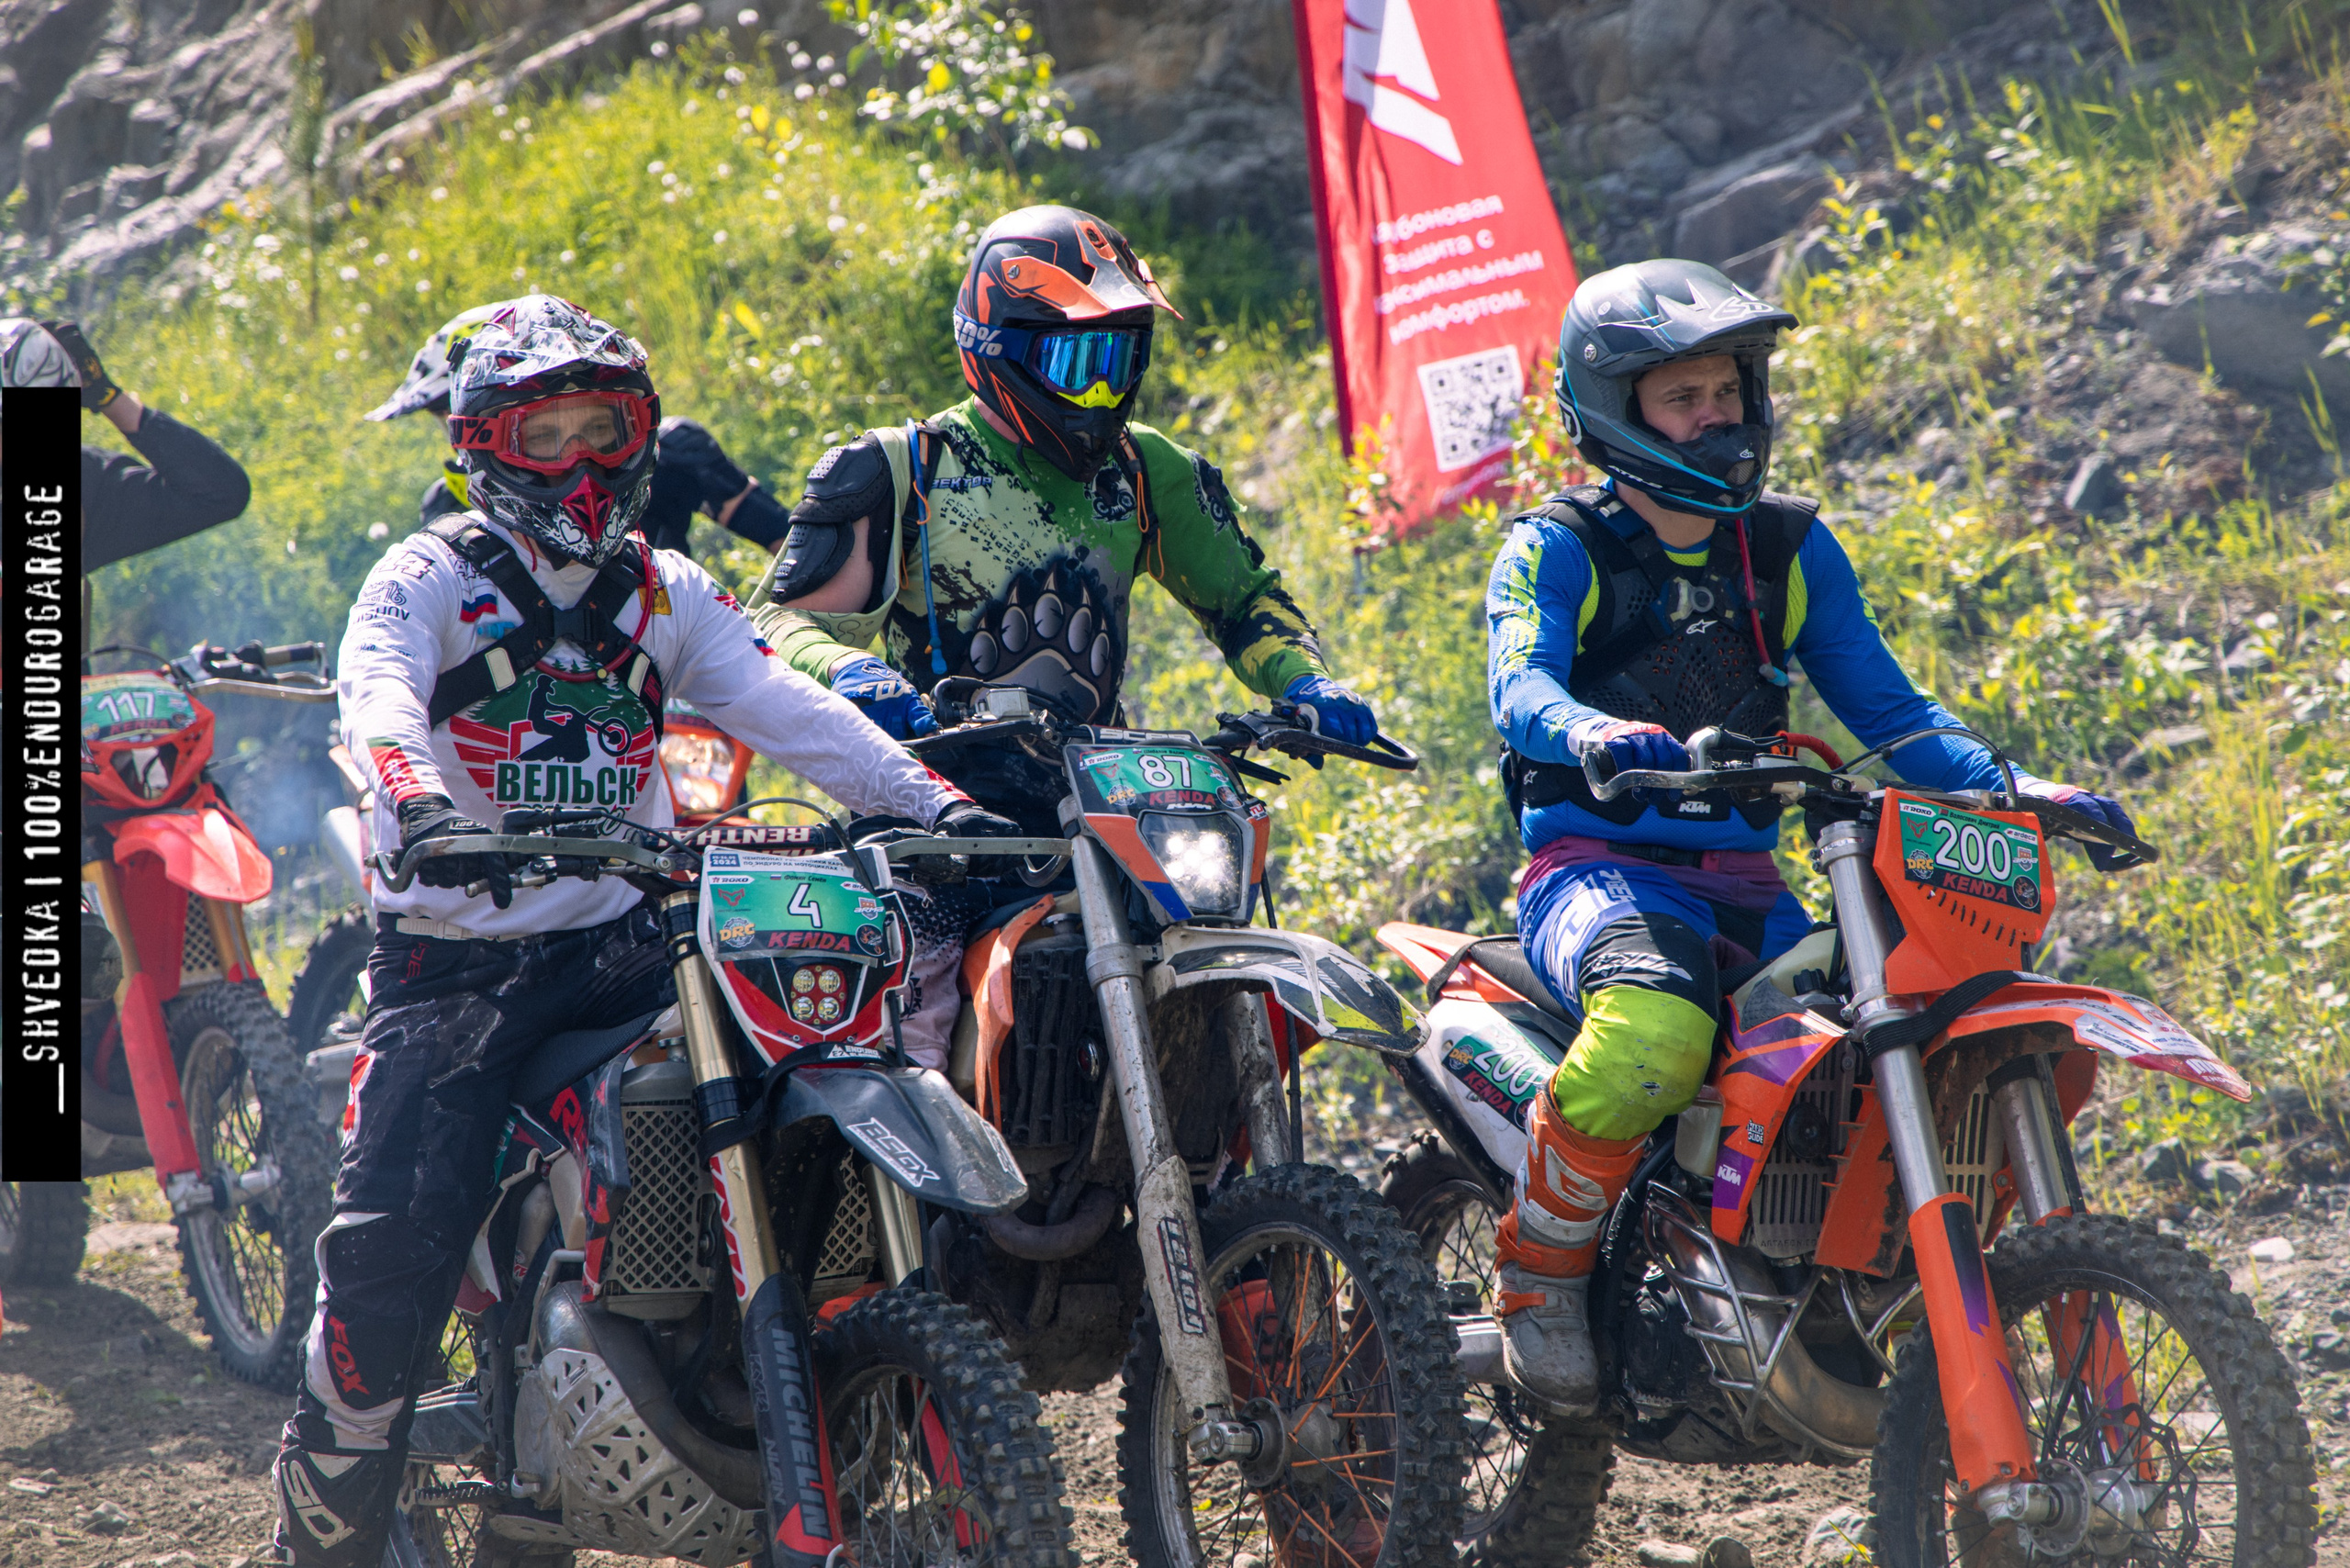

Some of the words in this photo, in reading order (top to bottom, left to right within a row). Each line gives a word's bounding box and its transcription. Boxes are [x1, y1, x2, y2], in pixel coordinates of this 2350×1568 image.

[858, 679, 912, 702] FOX
[97, 692, 154, 722] 117
[497, 763, 637, 805] ВЕЛЬСК
[1138, 755, 1192, 788] 87
[1149, 790, 1216, 807] KENDA
[1679, 801, 1711, 813] KTM
[1907, 858, 1934, 870] DRC
[1932, 818, 2012, 881] 200
[1943, 873, 2009, 902] KENDA
[787, 882, 822, 928] 4
[719, 923, 756, 942] DRC
[767, 932, 851, 952] KENDA
[1449, 1047, 1473, 1065] DRC
[1472, 1038, 1547, 1097] 200
[1463, 1070, 1513, 1114] KENDA
[1748, 1132, 1763, 1144] GLIDE
[1718, 1164, 1741, 1186] KTM
[328, 1316, 370, 1396] FOX
[771, 1327, 832, 1540] MICHELIN
